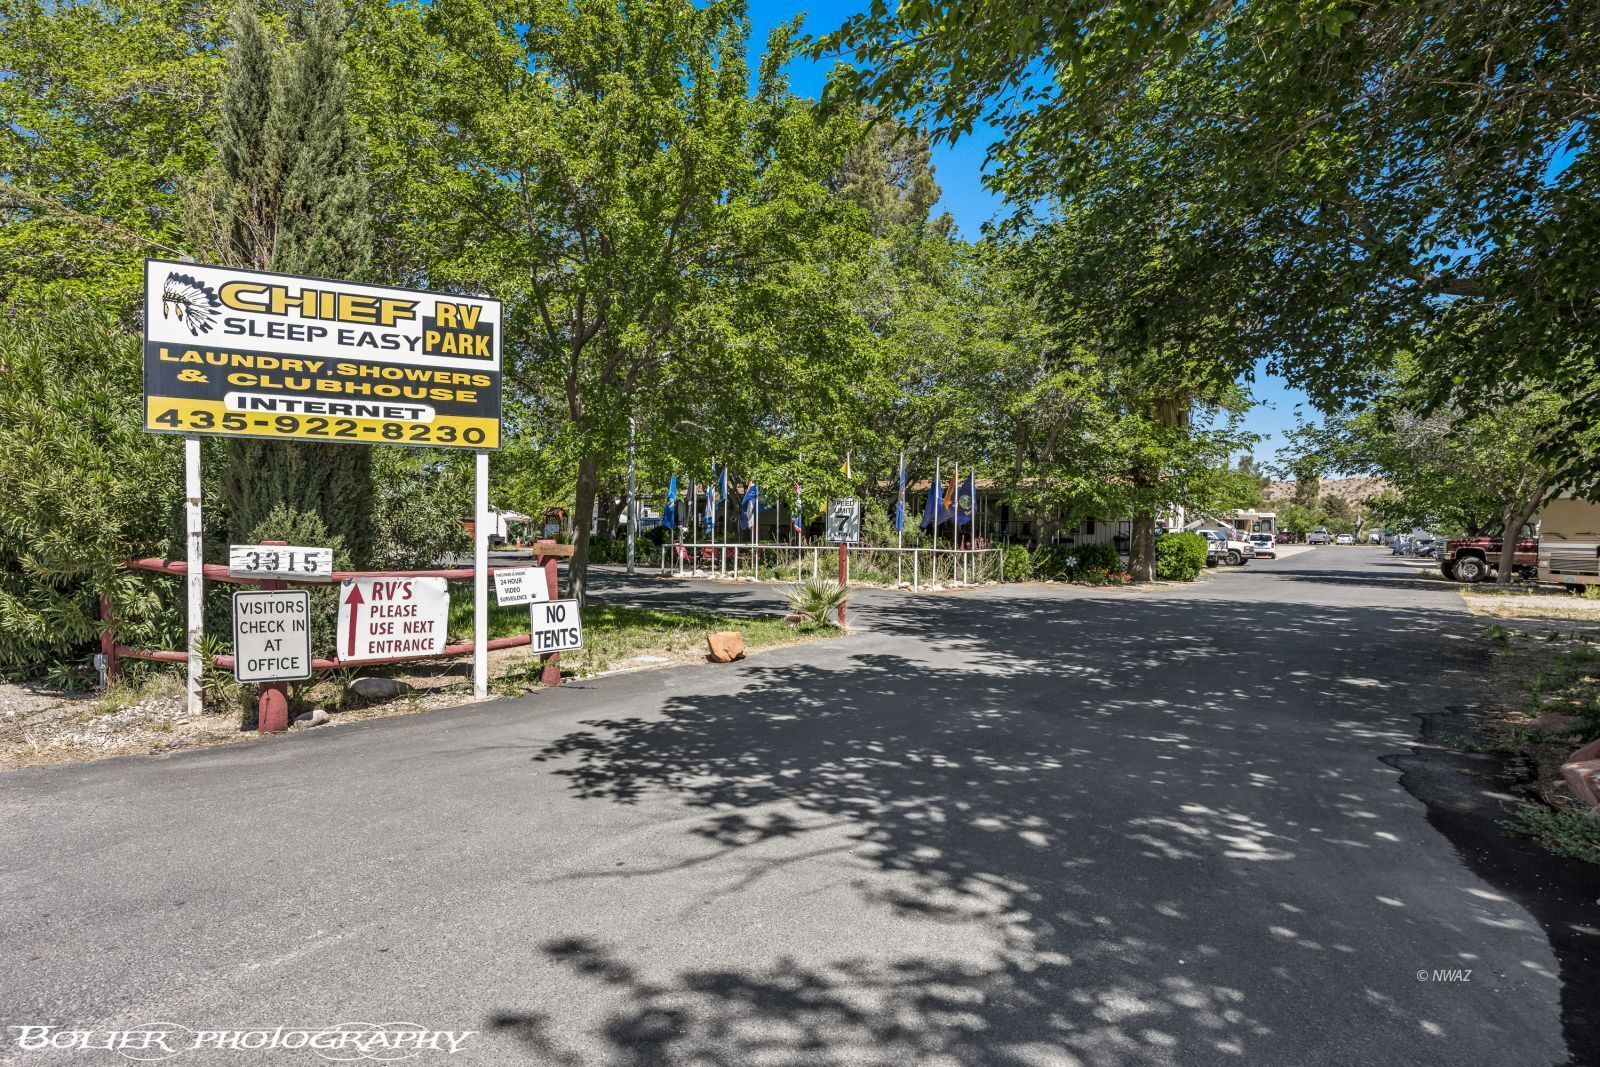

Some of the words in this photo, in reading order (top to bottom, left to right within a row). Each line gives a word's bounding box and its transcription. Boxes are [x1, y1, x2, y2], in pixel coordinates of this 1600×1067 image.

[217, 280, 421, 329] CHIEF
[435, 301, 483, 330] RV
[223, 317, 328, 343] SLEEP
[337, 327, 422, 352] EASY
[425, 330, 490, 357] PARK
[337, 363, 491, 387] SHOWERS
[176, 369, 211, 383] &
[227, 372, 478, 403] CLUBHOUSE
[237, 396, 425, 420] INTERNET
[155, 408, 487, 444] 435-922-8230
[836, 515, 850, 531] 7
[246, 551, 319, 572] 3315
[371, 581, 413, 601] RV'S
[239, 600, 304, 615] VISITORS
[370, 604, 417, 618] PLEASE
[546, 604, 566, 624] NO
[240, 620, 285, 634] CHECK
[292, 619, 305, 632] IN
[369, 622, 394, 635] USE
[403, 620, 435, 634] NEXT
[264, 638, 283, 652] AT
[368, 637, 434, 654] ENTRANCE
[534, 627, 579, 649] TENTS
[247, 656, 300, 672] OFFICE
